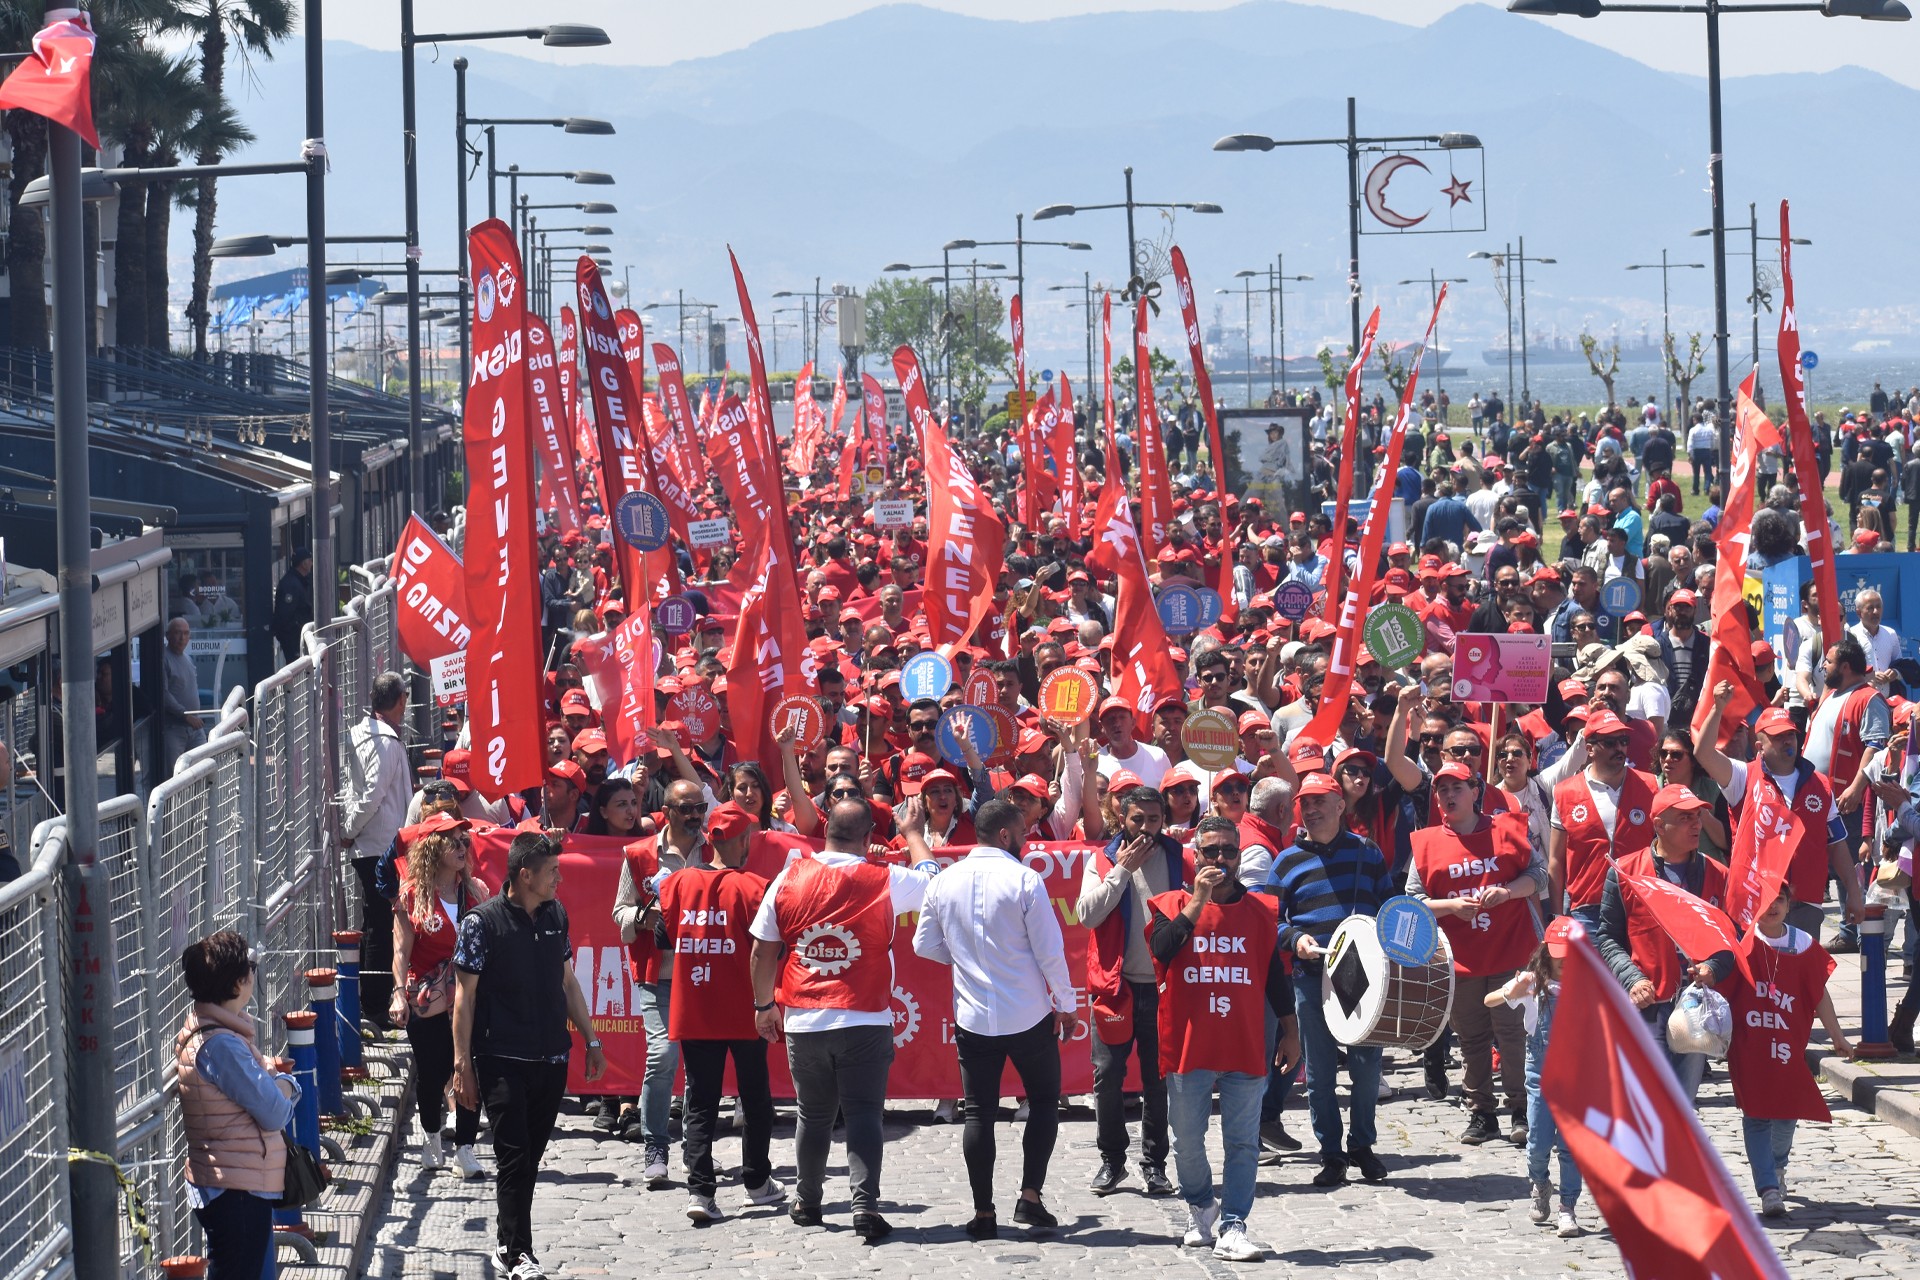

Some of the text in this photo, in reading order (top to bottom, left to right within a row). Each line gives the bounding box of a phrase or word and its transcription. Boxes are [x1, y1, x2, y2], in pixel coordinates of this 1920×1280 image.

[1178, 594, 1188, 626] ADALET
[1277, 593, 1310, 605] KADRO
[1389, 614, 1411, 650] DOĞA
[191, 642, 221, 651] BODRUM
[441, 666, 467, 679] SÖMÜ
[926, 661, 935, 695] ADALET
[444, 679, 458, 690] BİR
[1068, 679, 1081, 712] EMEK
[674, 691, 713, 711] KADRO
[795, 707, 809, 742] HUKUK
[1448, 856, 1500, 879] DİSK
[1470, 911, 1492, 932] İŞ
[807, 941, 846, 959] DİSK
[1192, 931, 1247, 954] DİSK
[1183, 966, 1252, 985] GENEL
[1209, 991, 1232, 1018] İŞ
[81, 1007, 95, 1025] K
[1771, 1037, 1792, 1065] İŞ
